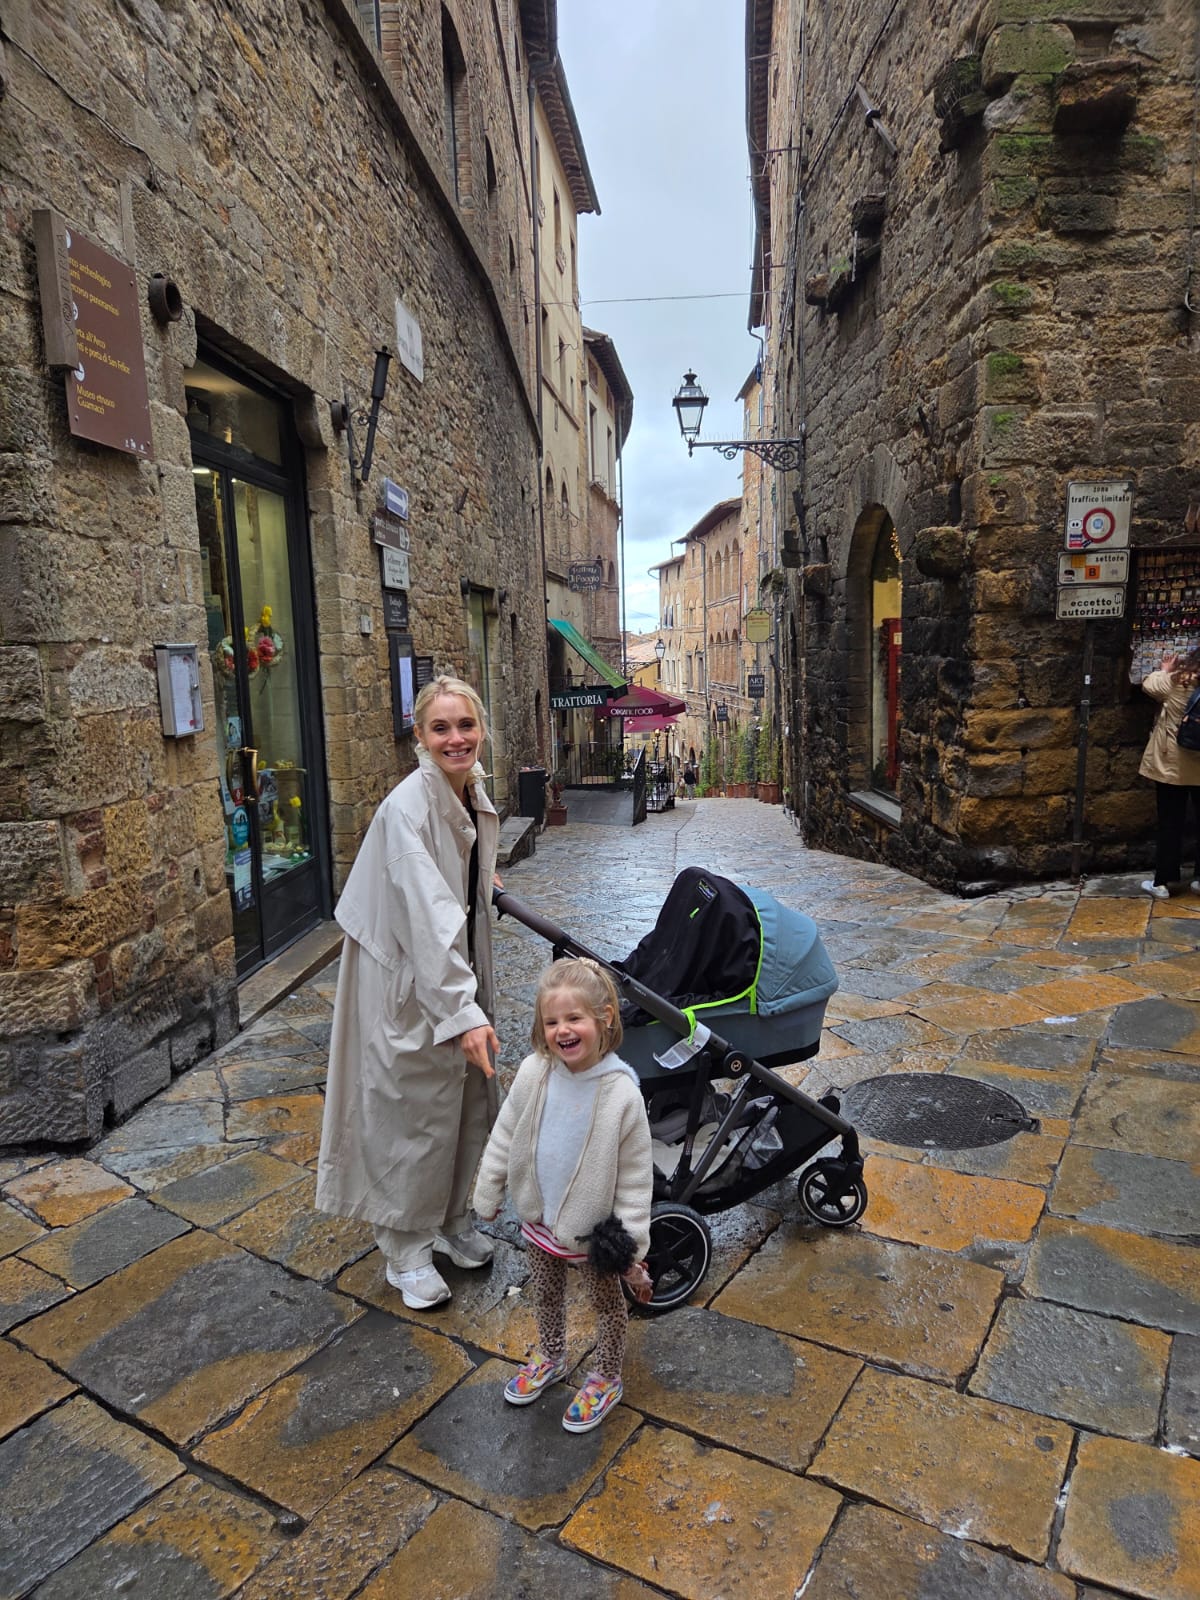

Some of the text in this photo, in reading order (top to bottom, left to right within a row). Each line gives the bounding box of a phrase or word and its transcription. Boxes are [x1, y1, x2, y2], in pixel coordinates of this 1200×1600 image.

[89, 348, 103, 361] porta
[76, 384, 116, 409] Museo etrusco
[1071, 494, 1130, 503] traffico limitato
[1095, 555, 1124, 563] settore
[1088, 567, 1096, 577] B
[1070, 598, 1112, 607] eccetto
[1061, 606, 1120, 617] autorizzati
[551, 694, 604, 708] TRATTORIA
[634, 707, 654, 716] FOOD
